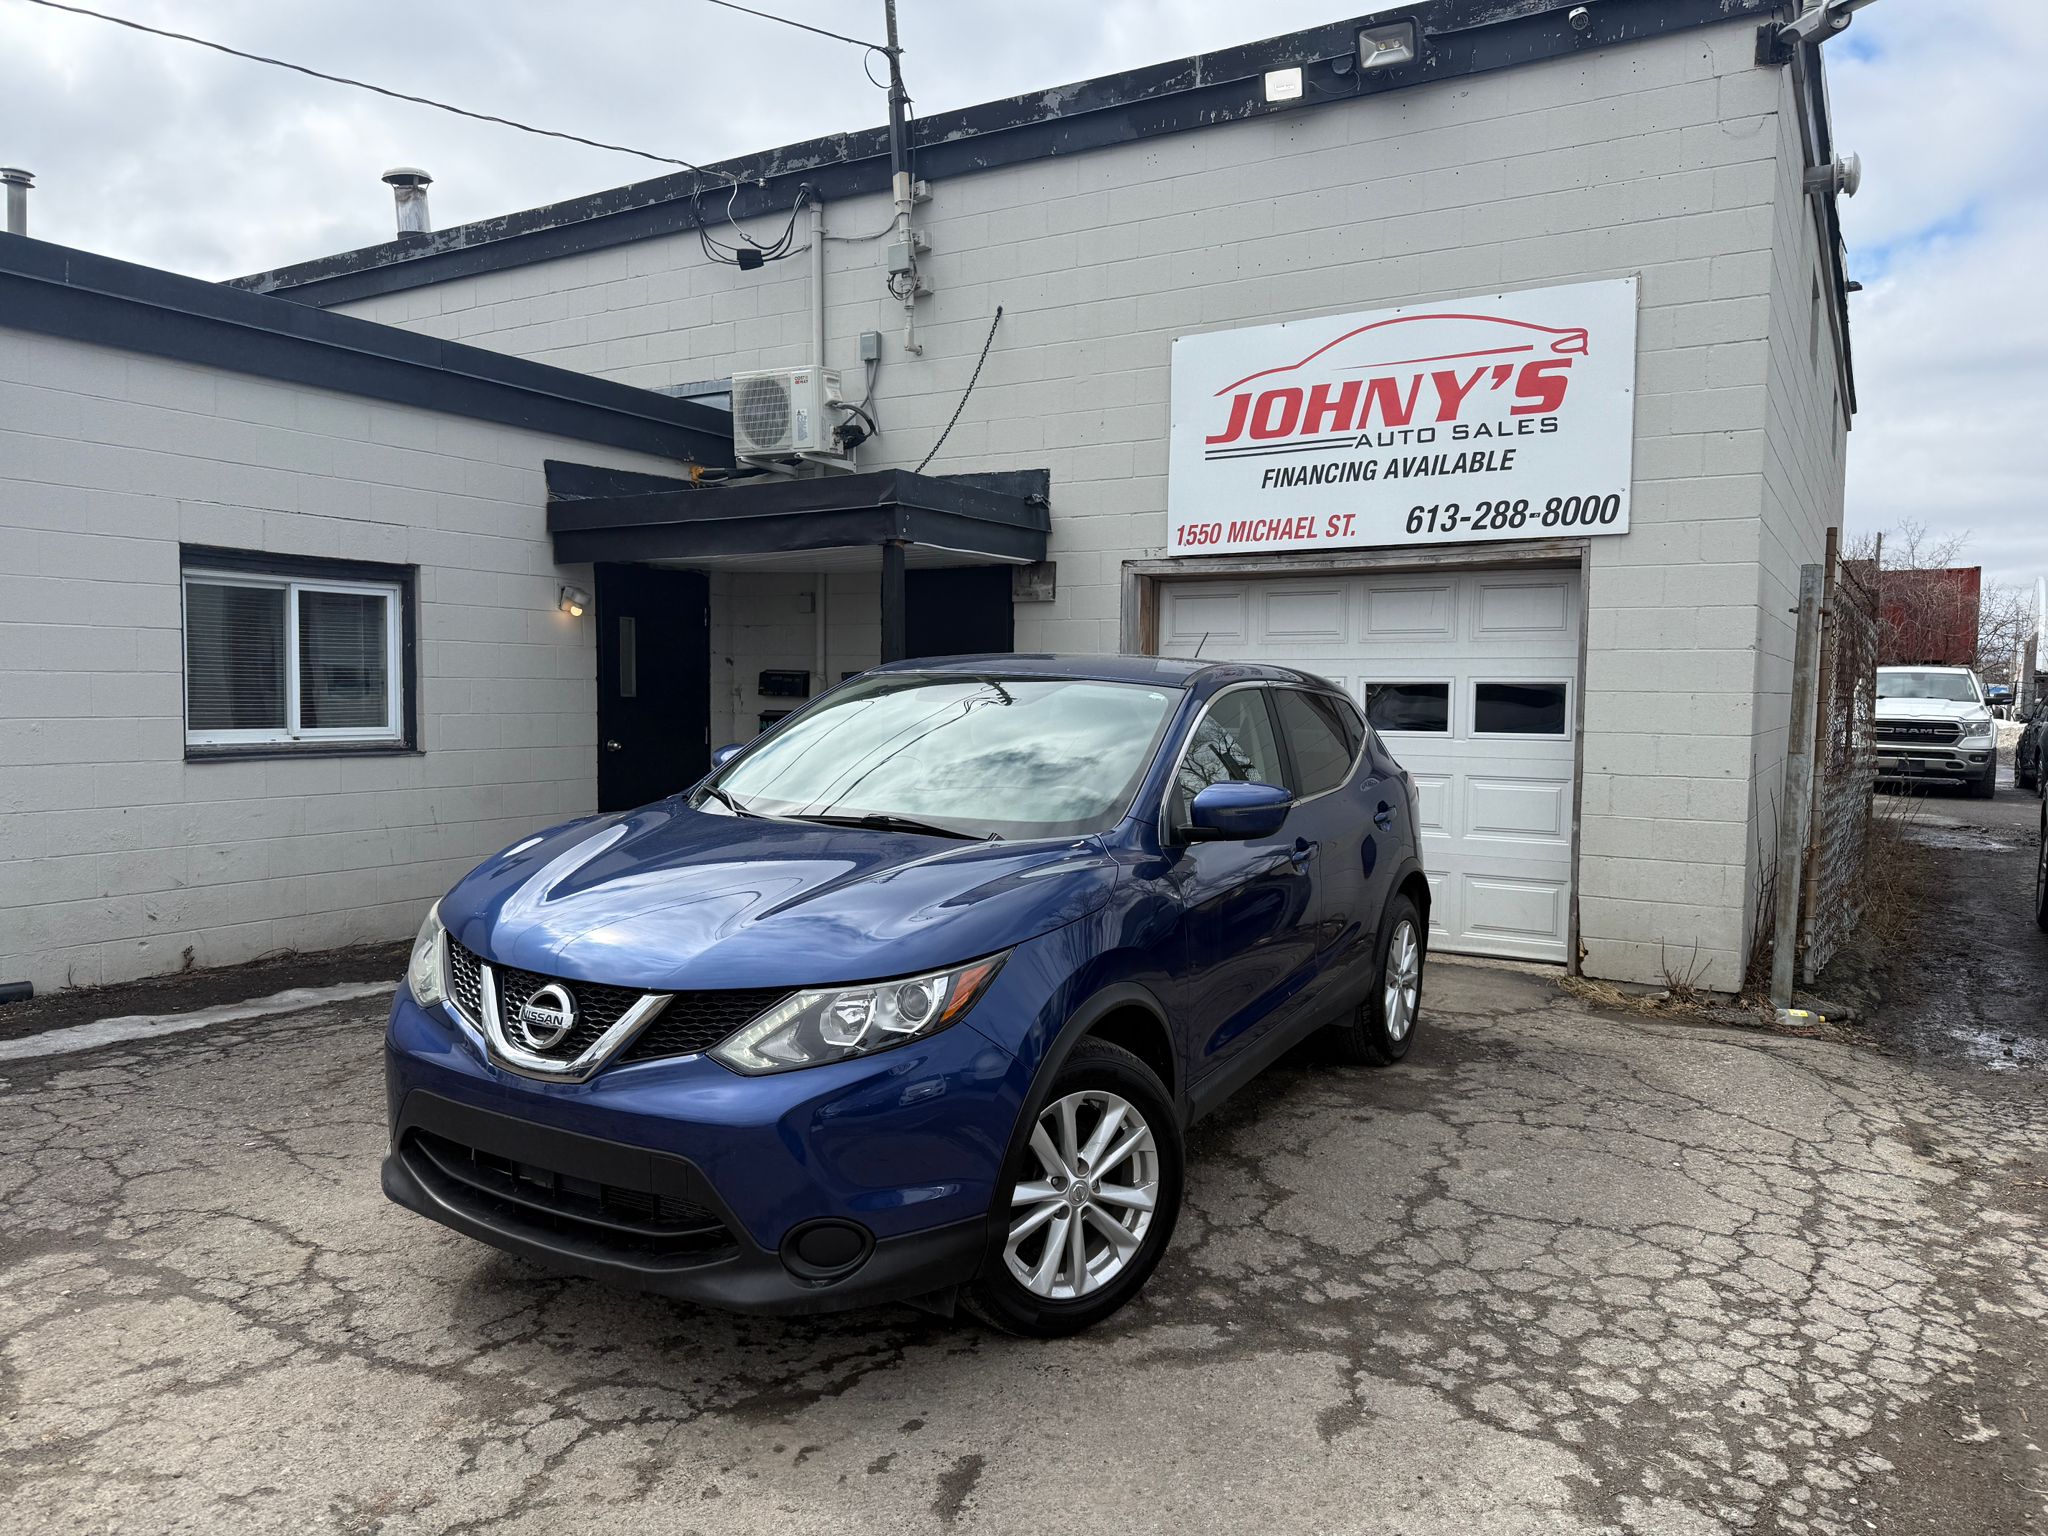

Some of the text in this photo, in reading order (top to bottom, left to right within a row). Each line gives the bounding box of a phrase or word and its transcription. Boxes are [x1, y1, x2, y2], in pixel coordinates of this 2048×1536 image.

[1205, 358, 1573, 444] JOHNY'S
[1355, 416, 1558, 449] AUTO SALES
[1261, 449, 1517, 489] FINANCING AVAILABLE
[1176, 513, 1356, 546] 1550 MICHAEL ST.
[1405, 494, 1621, 534] 613-288-8000
[521, 1010, 564, 1026] NISSAN
